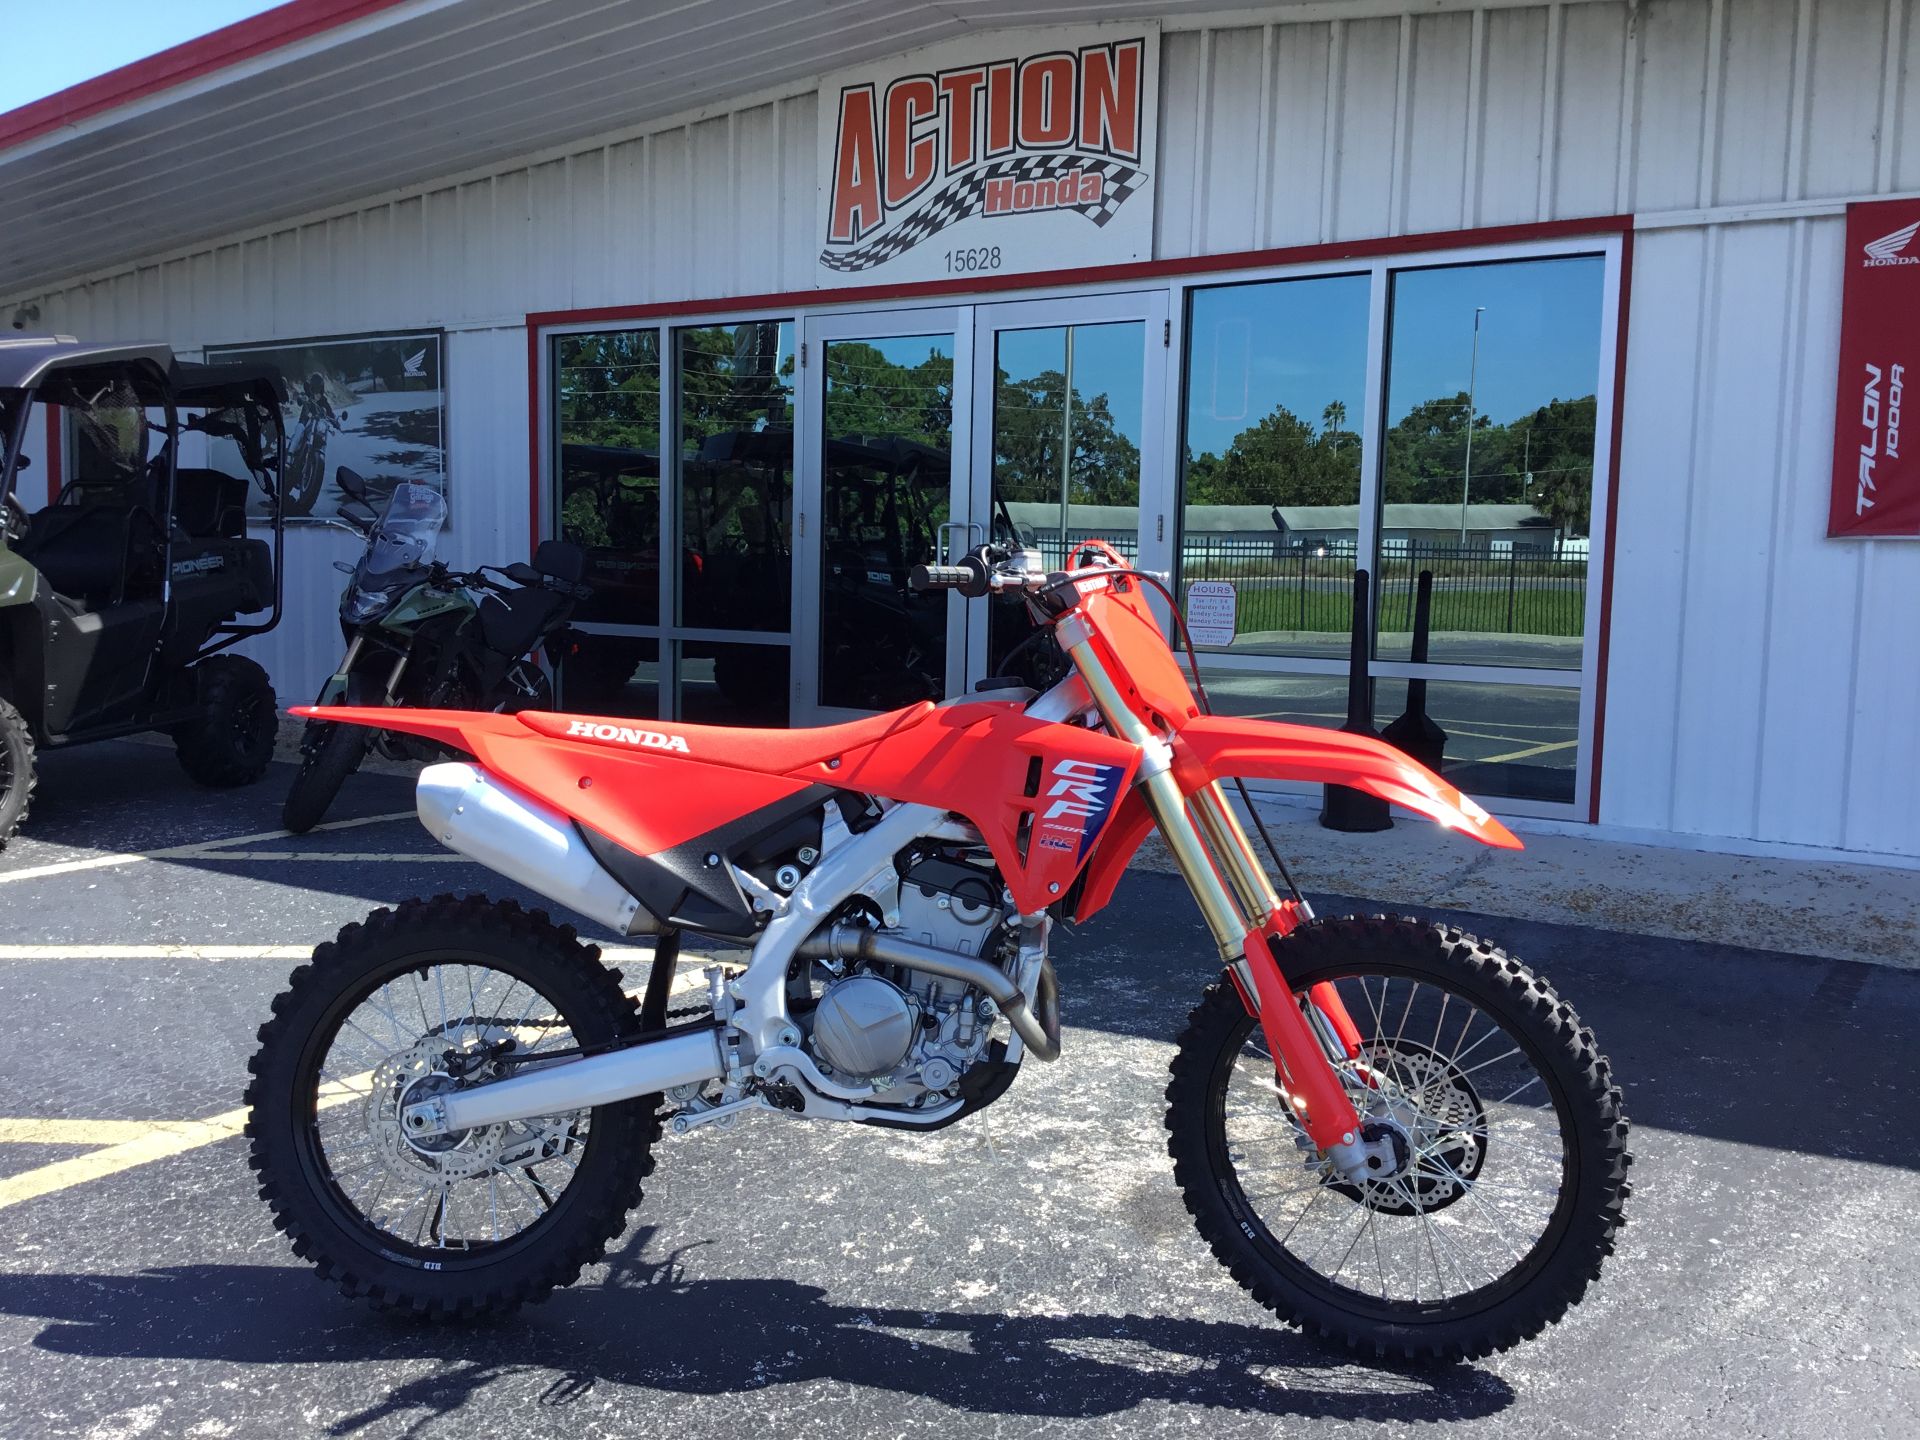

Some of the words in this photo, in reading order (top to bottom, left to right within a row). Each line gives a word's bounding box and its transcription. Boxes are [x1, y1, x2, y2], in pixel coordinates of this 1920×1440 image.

[826, 37, 1145, 245] ACTION
[982, 168, 1105, 218] Honda
[944, 246, 1001, 273] 15628
[1863, 257, 1920, 267] HONDA
[1886, 363, 1905, 459] 1000R
[1856, 363, 1882, 517] TALON
[172, 556, 224, 575] PIONEER
[566, 720, 691, 753] HONDA
[1043, 759, 1112, 819] CRF
